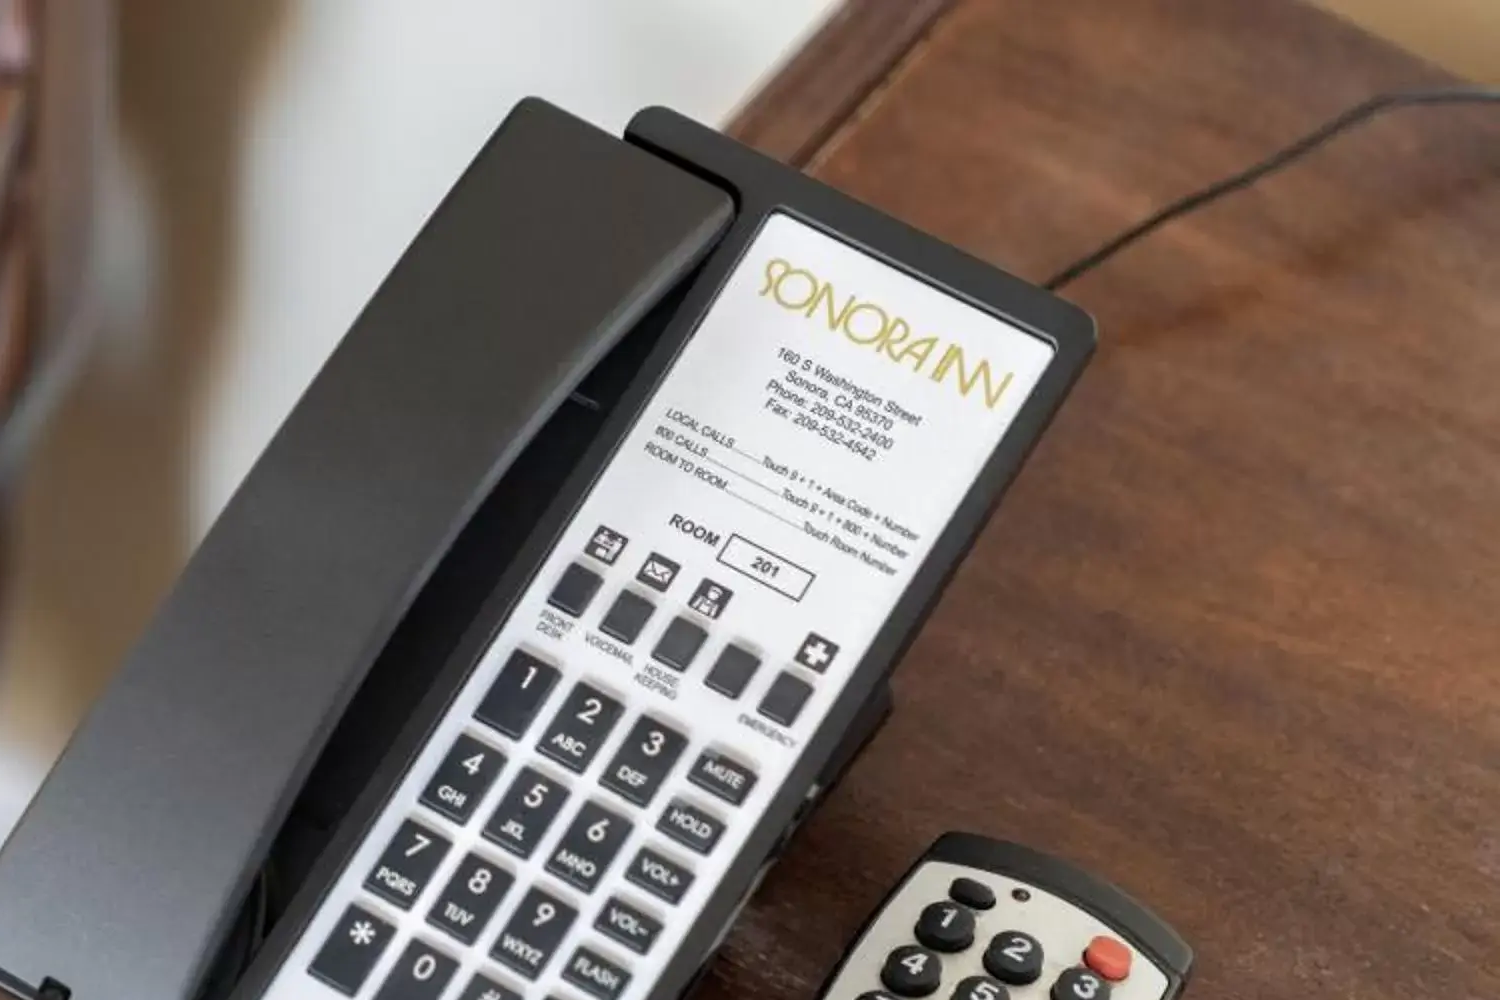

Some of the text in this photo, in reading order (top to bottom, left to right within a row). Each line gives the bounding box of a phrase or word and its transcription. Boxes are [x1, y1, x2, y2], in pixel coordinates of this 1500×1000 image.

[758, 257, 1014, 409] SONORA INN
[777, 346, 922, 427] 160 S Washington Street
[785, 370, 894, 430] Sonora, CA 95370
[765, 378, 894, 451] Phone: 209-532-2400
[765, 397, 877, 461] Fax: 209-532-4542
[665, 408, 699, 432] LOCAL
[762, 455, 789, 477] Touch
[822, 487, 846, 505] Area
[847, 499, 873, 518] Code
[881, 516, 920, 541] Number
[643, 441, 678, 466] ROOM
[677, 457, 695, 473] TO
[694, 466, 728, 490] ROOM
[803, 520, 830, 543] Touch
[859, 551, 898, 577] Number
[782, 487, 809, 509] Touch
[870, 533, 909, 558] Number
[668, 513, 720, 548] ROOM
[749, 556, 780, 578] 201
[520, 665, 538, 690] 1
[633, 672, 677, 701] KEEPING
[644, 664, 680, 688] HOUSE
[576, 698, 603, 725] 2
[551, 732, 588, 757] ABC
[641, 730, 666, 757] 3
[462, 752, 485, 776] 4
[615, 764, 649, 787] DEF
[703, 759, 746, 790] MUTE
[437, 784, 468, 809] GHI
[523, 783, 549, 808] 5
[586, 818, 611, 843] 6
[669, 808, 713, 839] HOLD
[405, 832, 431, 857] 7
[555, 848, 597, 877] MNO
[641, 857, 681, 887] VOL+
[375, 866, 417, 896] PQRS
[467, 868, 492, 894] 8
[444, 902, 475, 927] TUV
[532, 902, 557, 926] 9
[940, 907, 958, 929] 1
[502, 933, 545, 966] WXYZ
[1003, 937, 1033, 962] 2
[412, 954, 436, 981] 0
[573, 955, 621, 990] FLASH
[900, 952, 929, 975] 4
[1072, 975, 1099, 1000] 3
